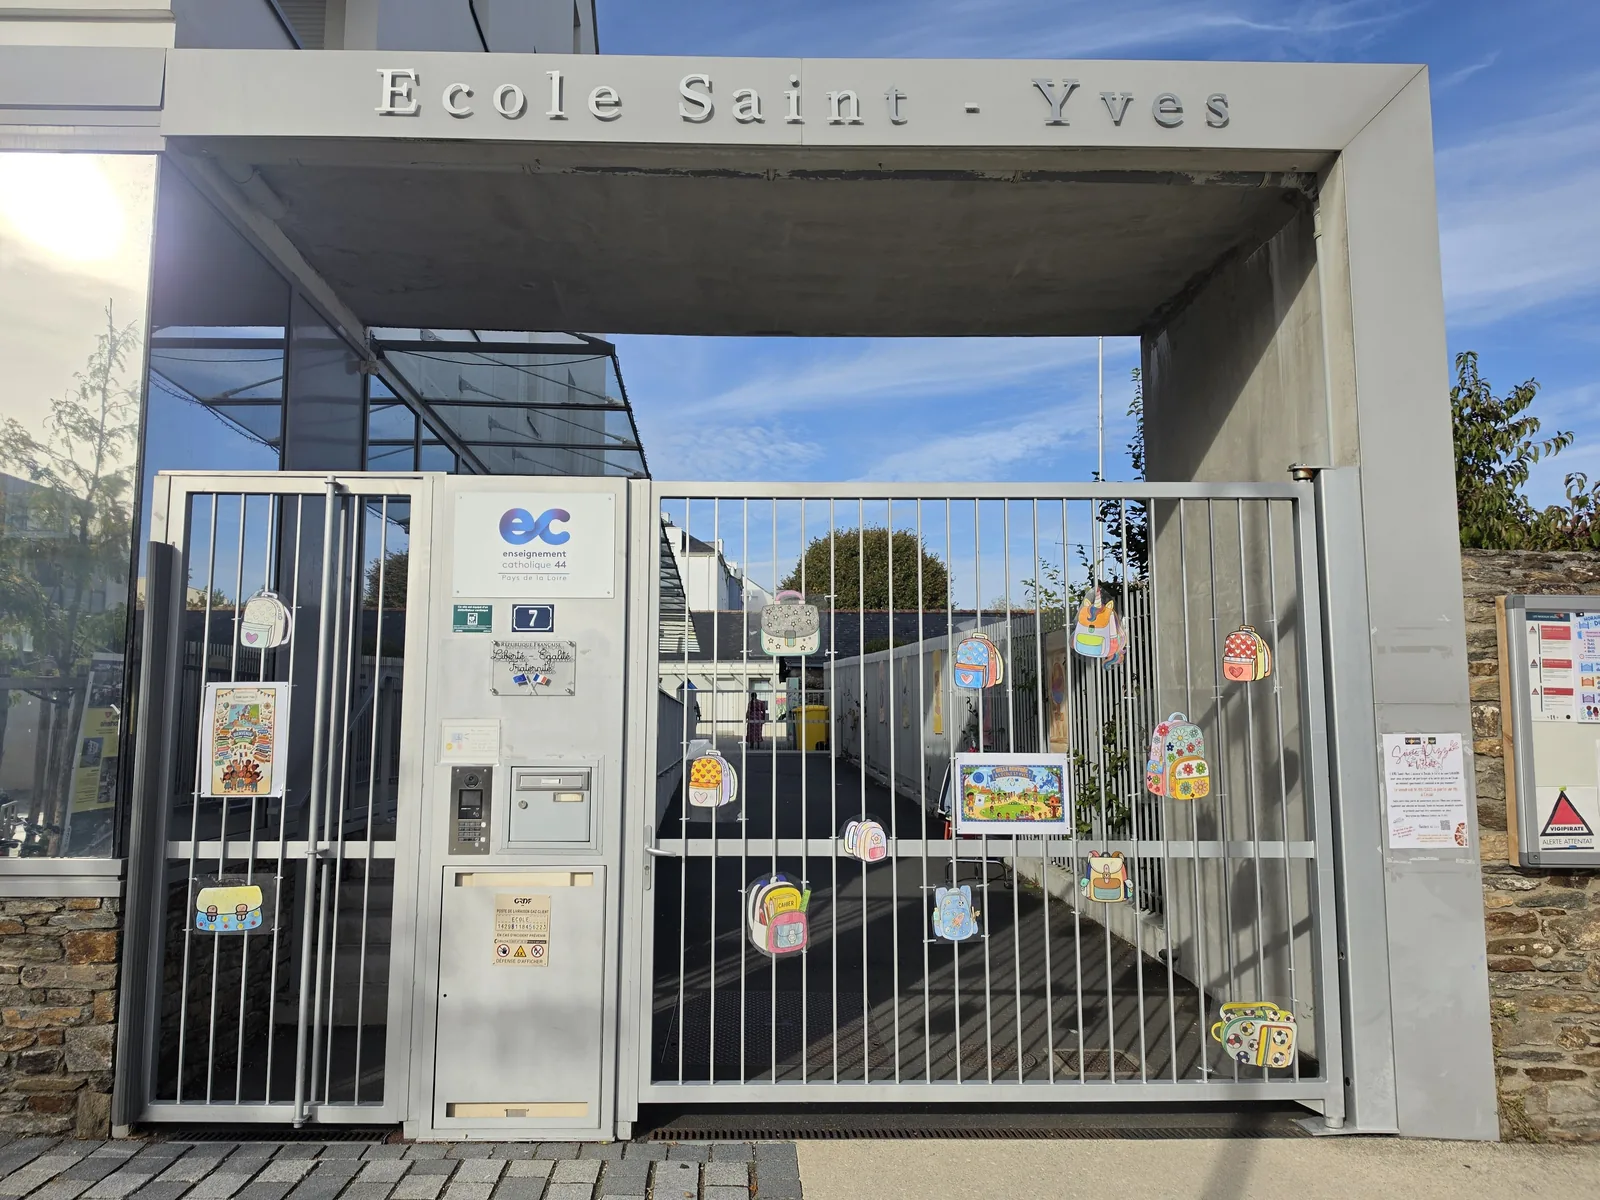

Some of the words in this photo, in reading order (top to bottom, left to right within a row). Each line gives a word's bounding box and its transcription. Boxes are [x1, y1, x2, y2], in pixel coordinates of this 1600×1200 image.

[374, 68, 620, 119] Ecole
[678, 72, 907, 123] Saint
[964, 101, 979, 110] -
[1030, 78, 1230, 126] Yves
[502, 550, 567, 559] enseignement
[502, 560, 551, 570] catholique
[554, 561, 567, 569] 44
[501, 574, 520, 582] Pays
[528, 609, 538, 627] 7
[491, 649, 526, 660] Liberté
[509, 660, 552, 672] Fraternité
[778, 900, 795, 909] CAHIER
